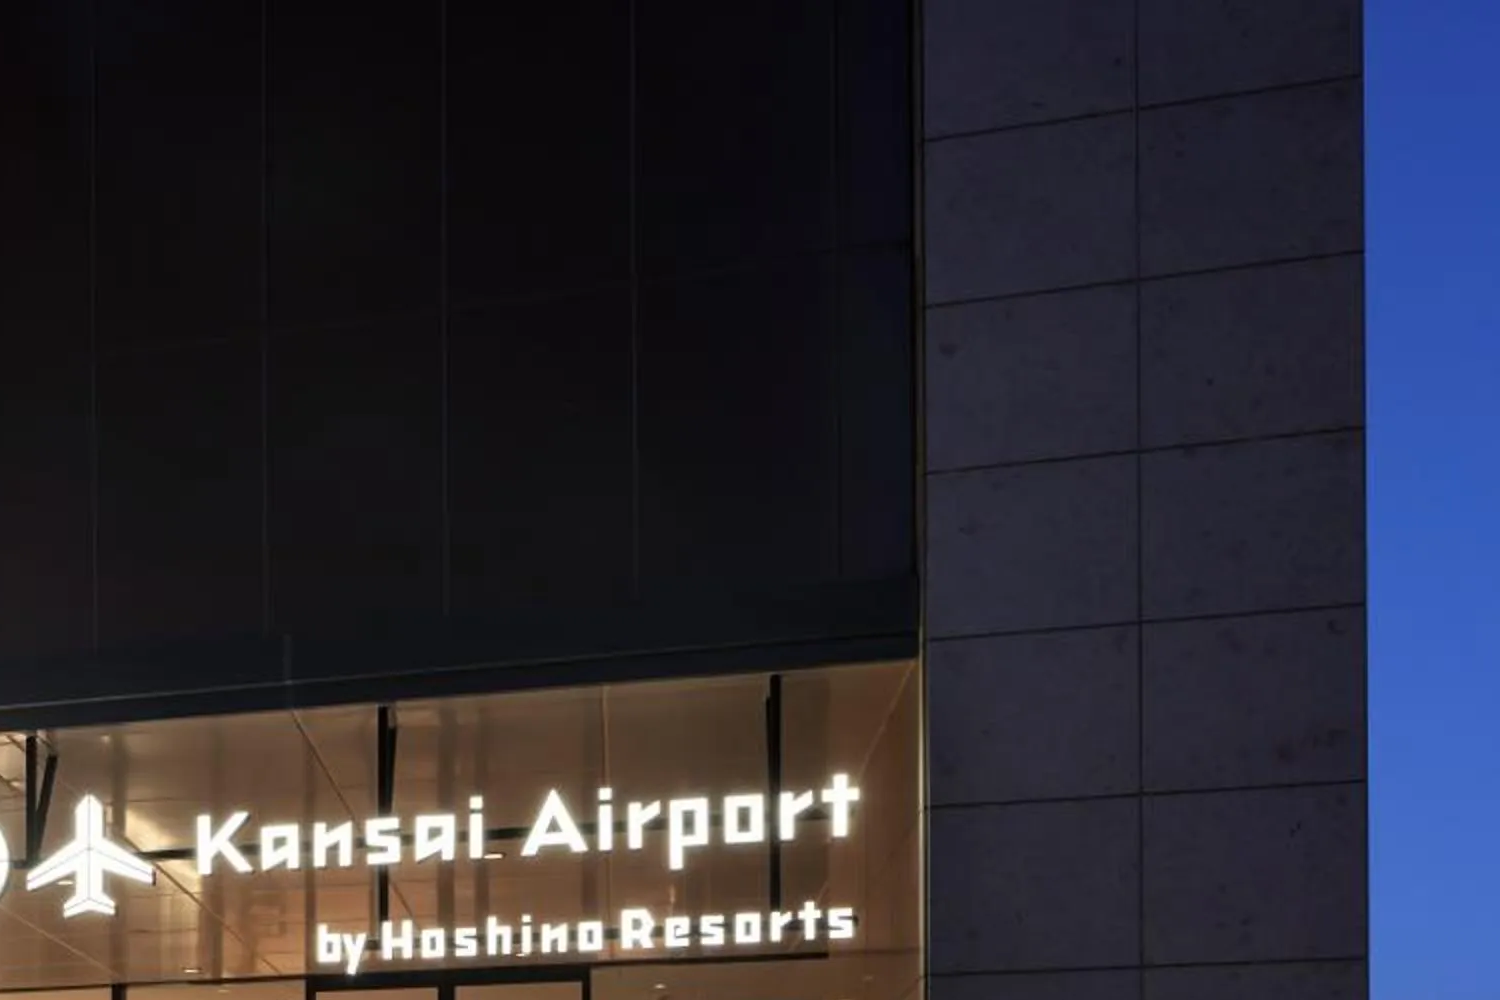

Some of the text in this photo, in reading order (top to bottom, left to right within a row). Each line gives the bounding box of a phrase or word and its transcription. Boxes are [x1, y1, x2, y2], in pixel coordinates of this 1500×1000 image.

[196, 796, 483, 876] Kansai
[521, 773, 860, 870] Airport
[317, 901, 854, 975] by Hoshino Resorts
